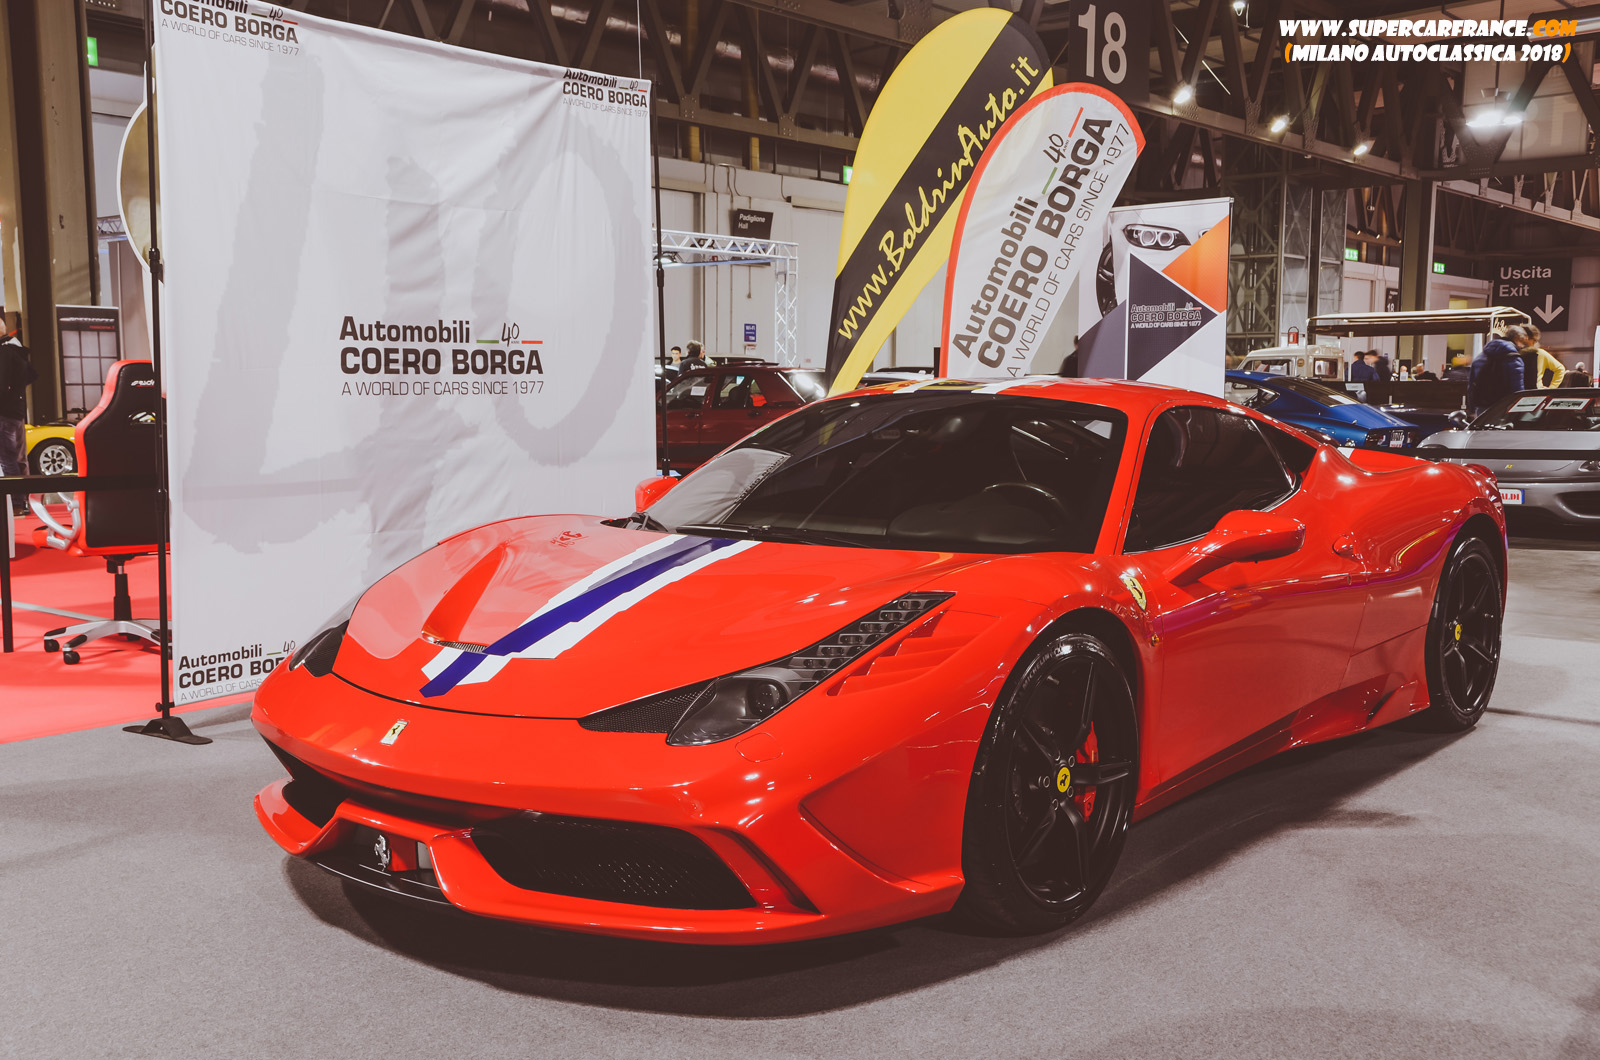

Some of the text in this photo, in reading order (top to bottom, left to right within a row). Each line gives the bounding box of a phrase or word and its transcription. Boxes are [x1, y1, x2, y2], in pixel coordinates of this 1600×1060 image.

[160, 0, 298, 44] COERO BORGA
[268, 7, 284, 21] 40
[161, 18, 300, 56] A WORLD OF CARS SINCE 1977
[1078, 4, 1127, 85] 18
[563, 69, 618, 88] Automobili
[562, 82, 648, 108] COERO BORGA
[568, 98, 590, 109] WORLD
[600, 104, 616, 114] CARS
[616, 106, 632, 116] SINCE
[634, 109, 648, 118] 1977
[1043, 134, 1066, 164] 40
[838, 55, 1040, 340] www.BoldrinAuto.it
[738, 222, 749, 230] Hall
[739, 213, 766, 224] Padiglione
[977, 118, 1113, 369] COERO BORGA
[1006, 122, 1130, 378] A WORLD OF CARS SINCE 1977
[952, 195, 1039, 359] Automobili
[1500, 265, 1552, 280] Uscita
[1499, 284, 1530, 297] Exit
[1131, 303, 1175, 313] Automobili
[1131, 311, 1202, 322] COERO BORGA
[339, 316, 470, 344] Automobili
[501, 322, 520, 347] 40
[340, 346, 544, 375] COERO BORGA
[341, 380, 544, 396] A WORLD OF CARS SINCE 1977
[178, 644, 262, 670] Automobili
[282, 640, 296, 654] 40
[179, 663, 243, 689] COERO
[180, 678, 262, 702] A WORLD OF CARS
